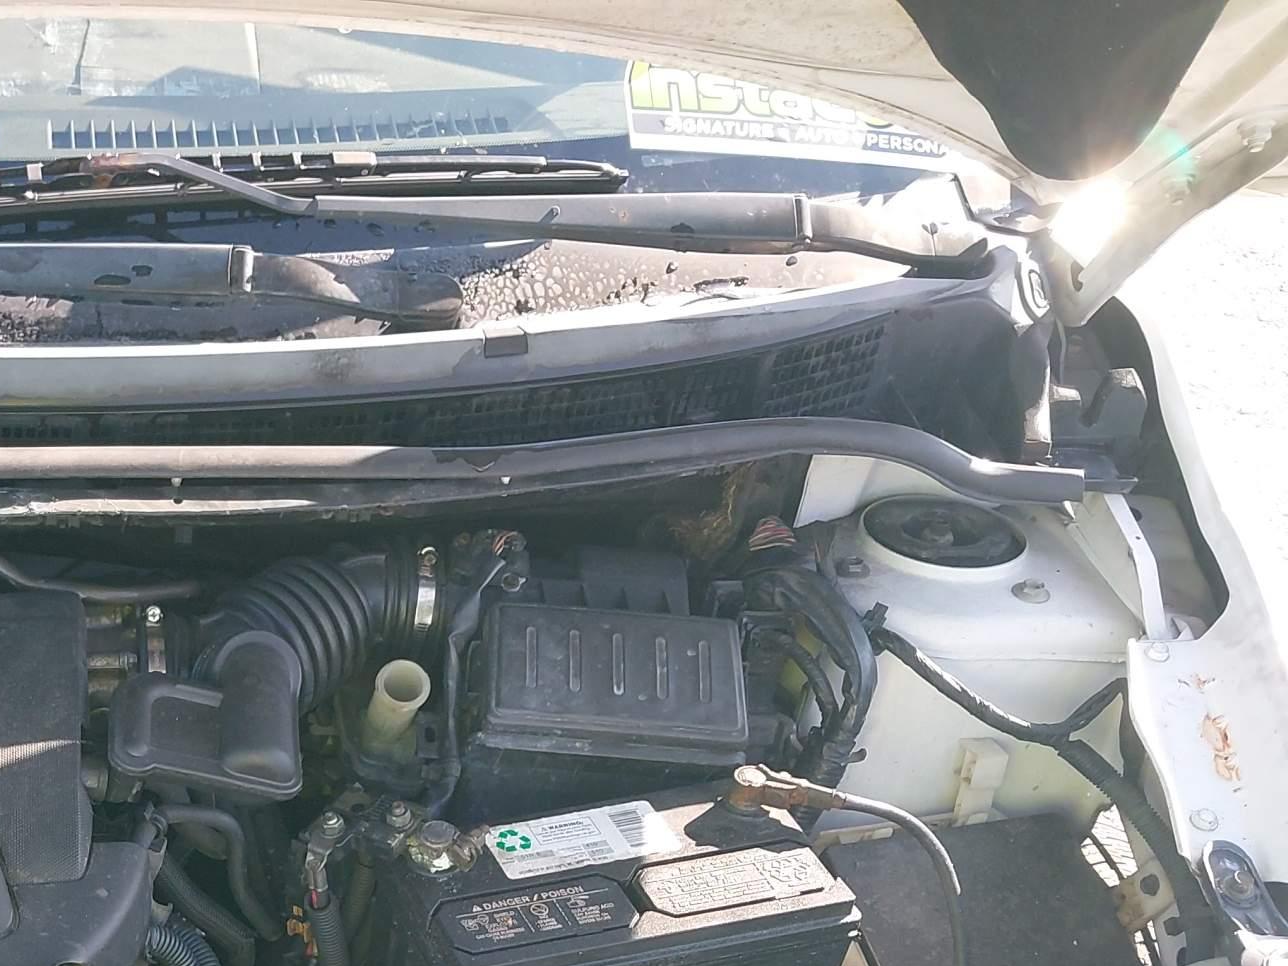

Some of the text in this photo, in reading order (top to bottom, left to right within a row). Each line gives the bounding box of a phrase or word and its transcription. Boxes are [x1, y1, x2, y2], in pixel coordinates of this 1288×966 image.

[664, 116, 774, 138] SIGNATURE
[482, 895, 531, 911] DANGER
[540, 885, 585, 899] POISON
